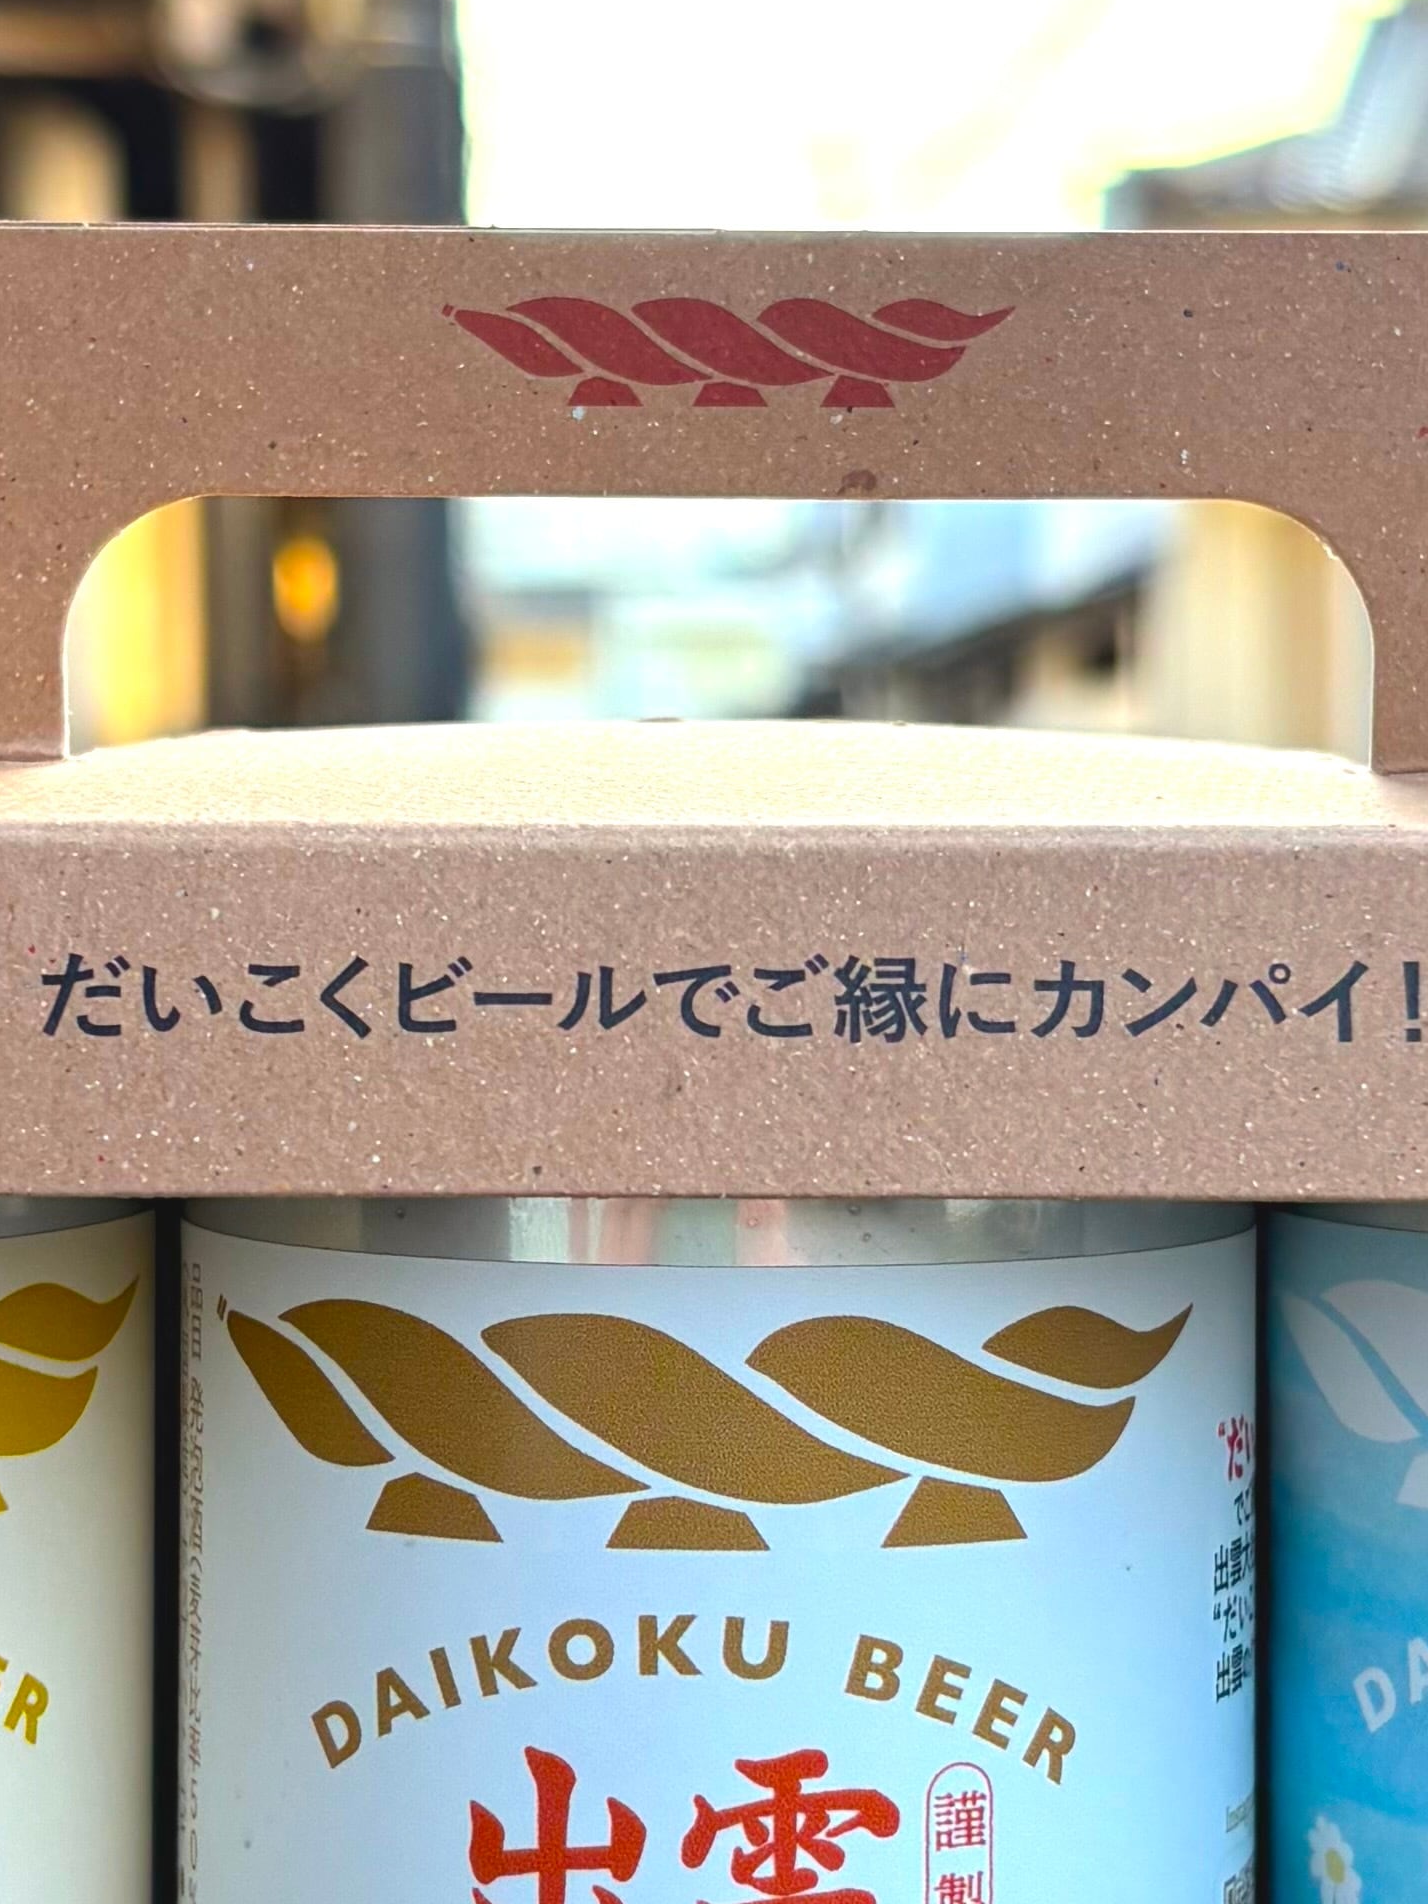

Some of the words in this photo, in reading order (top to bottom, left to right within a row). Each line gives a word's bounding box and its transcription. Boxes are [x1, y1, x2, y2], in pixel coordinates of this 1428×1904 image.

[39, 952, 1426, 1044] だいこくビールでご縁にカンパイ！
[310, 1614, 789, 1768] DAIKOKU
[844, 1634, 1076, 1785] BEER
